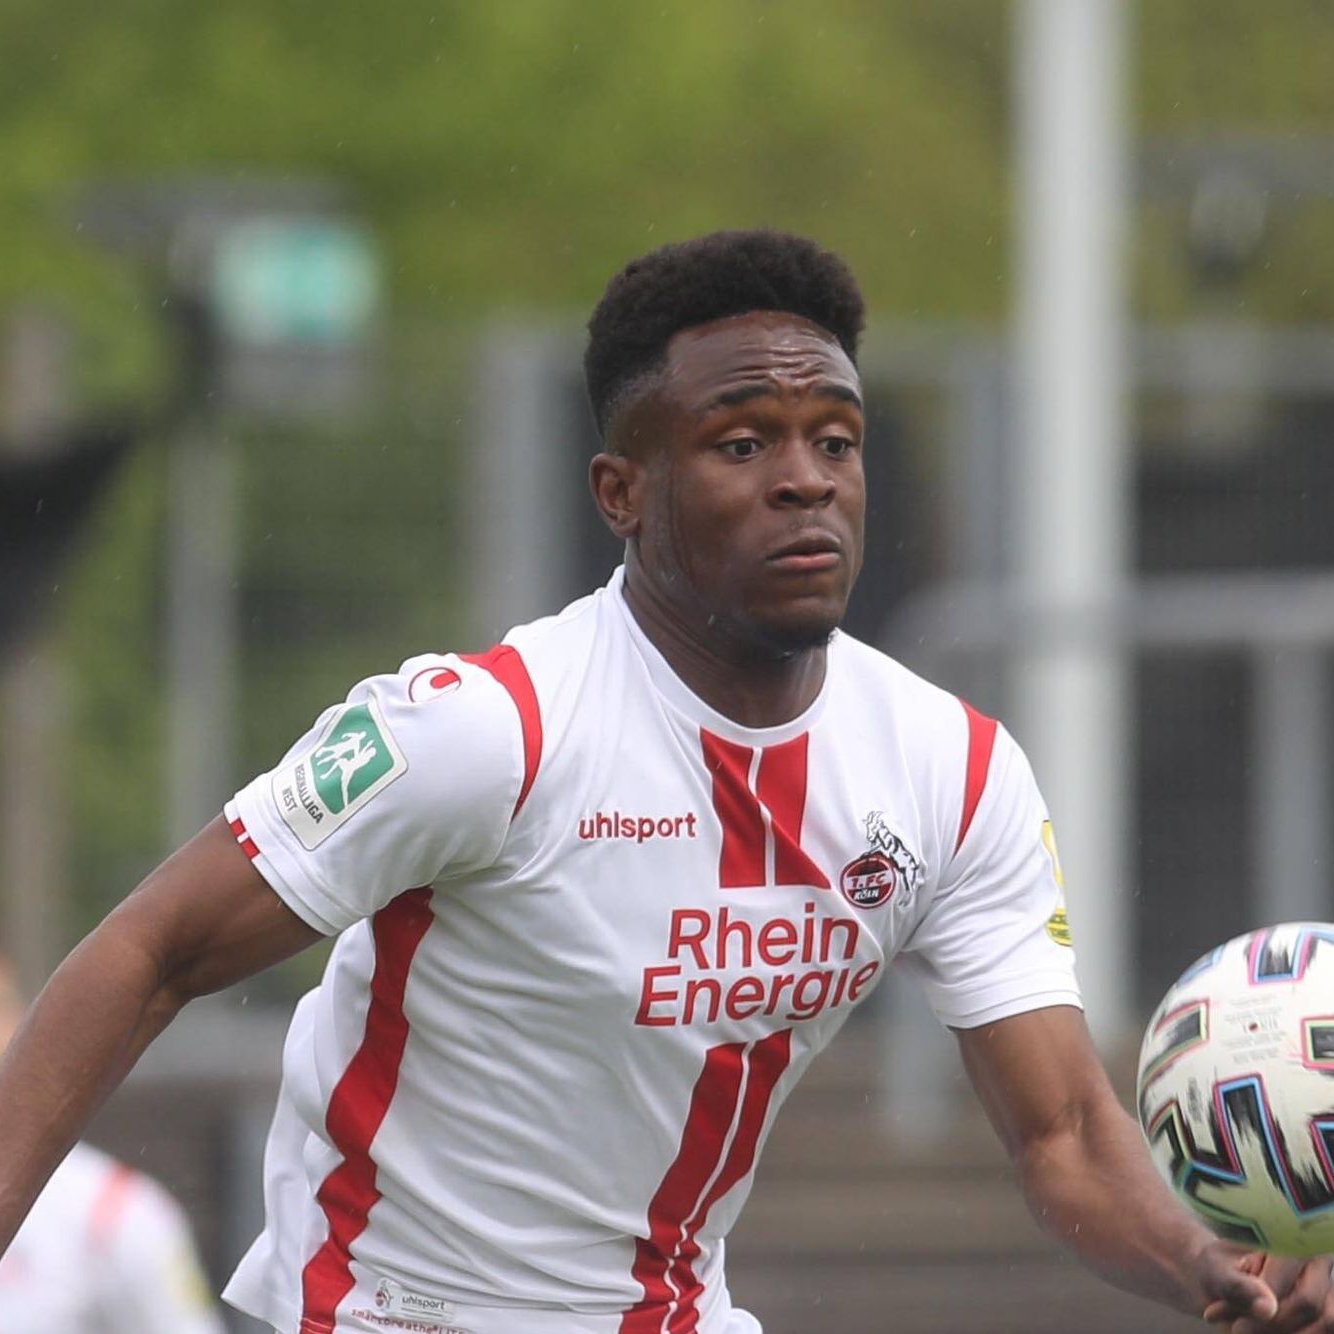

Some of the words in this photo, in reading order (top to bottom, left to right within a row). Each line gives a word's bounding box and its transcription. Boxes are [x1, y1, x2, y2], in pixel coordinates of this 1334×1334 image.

[578, 811, 696, 844] uhlsport
[668, 902, 860, 970] Rhein
[634, 961, 880, 1026] Energie
[401, 1294, 445, 1311] uhlsport
